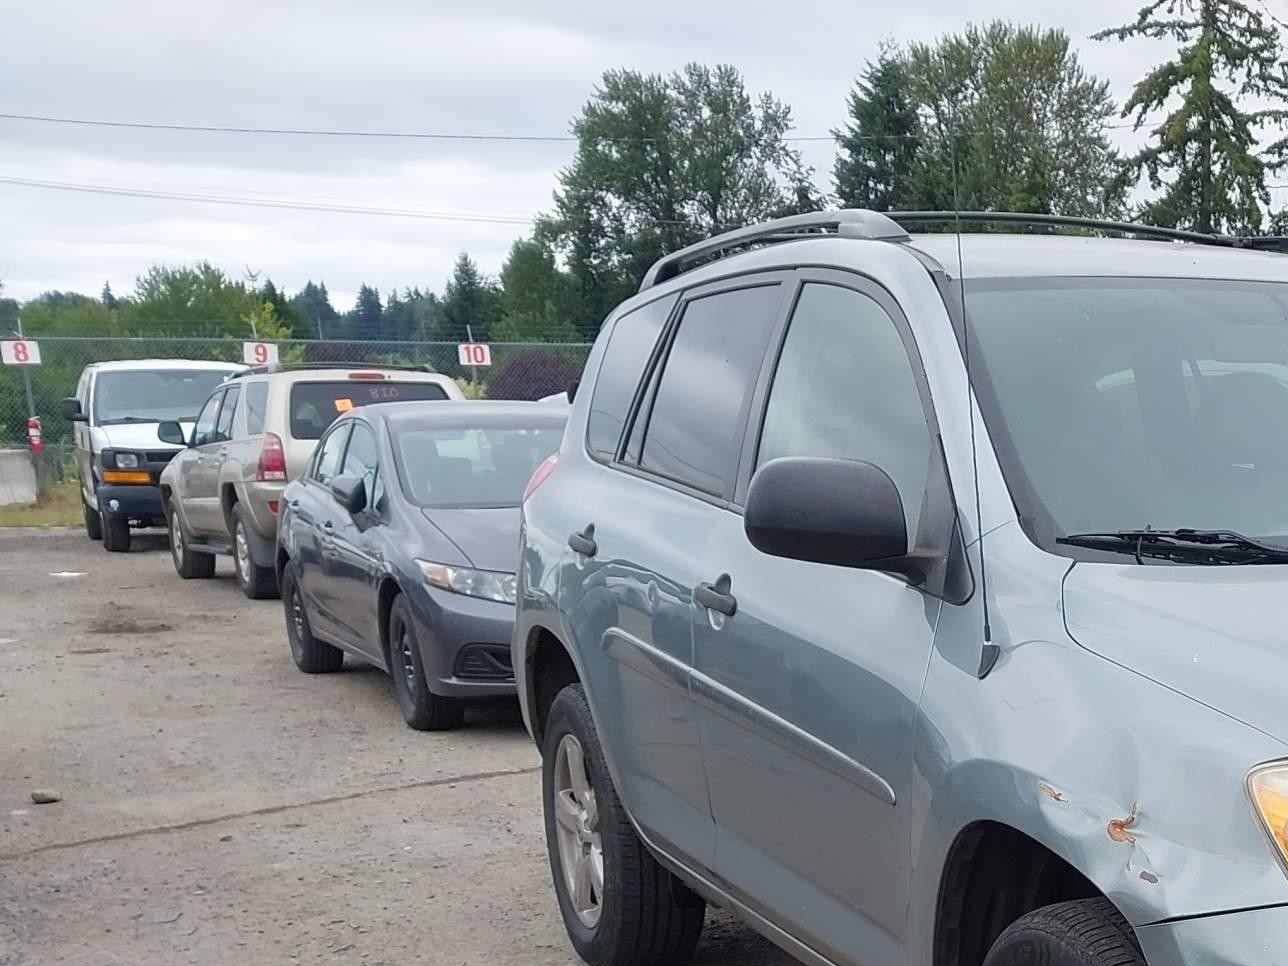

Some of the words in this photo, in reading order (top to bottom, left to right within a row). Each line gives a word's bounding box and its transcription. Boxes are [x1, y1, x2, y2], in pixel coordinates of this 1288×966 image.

[14, 342, 29, 361] 8
[254, 344, 268, 363] 9
[463, 345, 486, 363] 10
